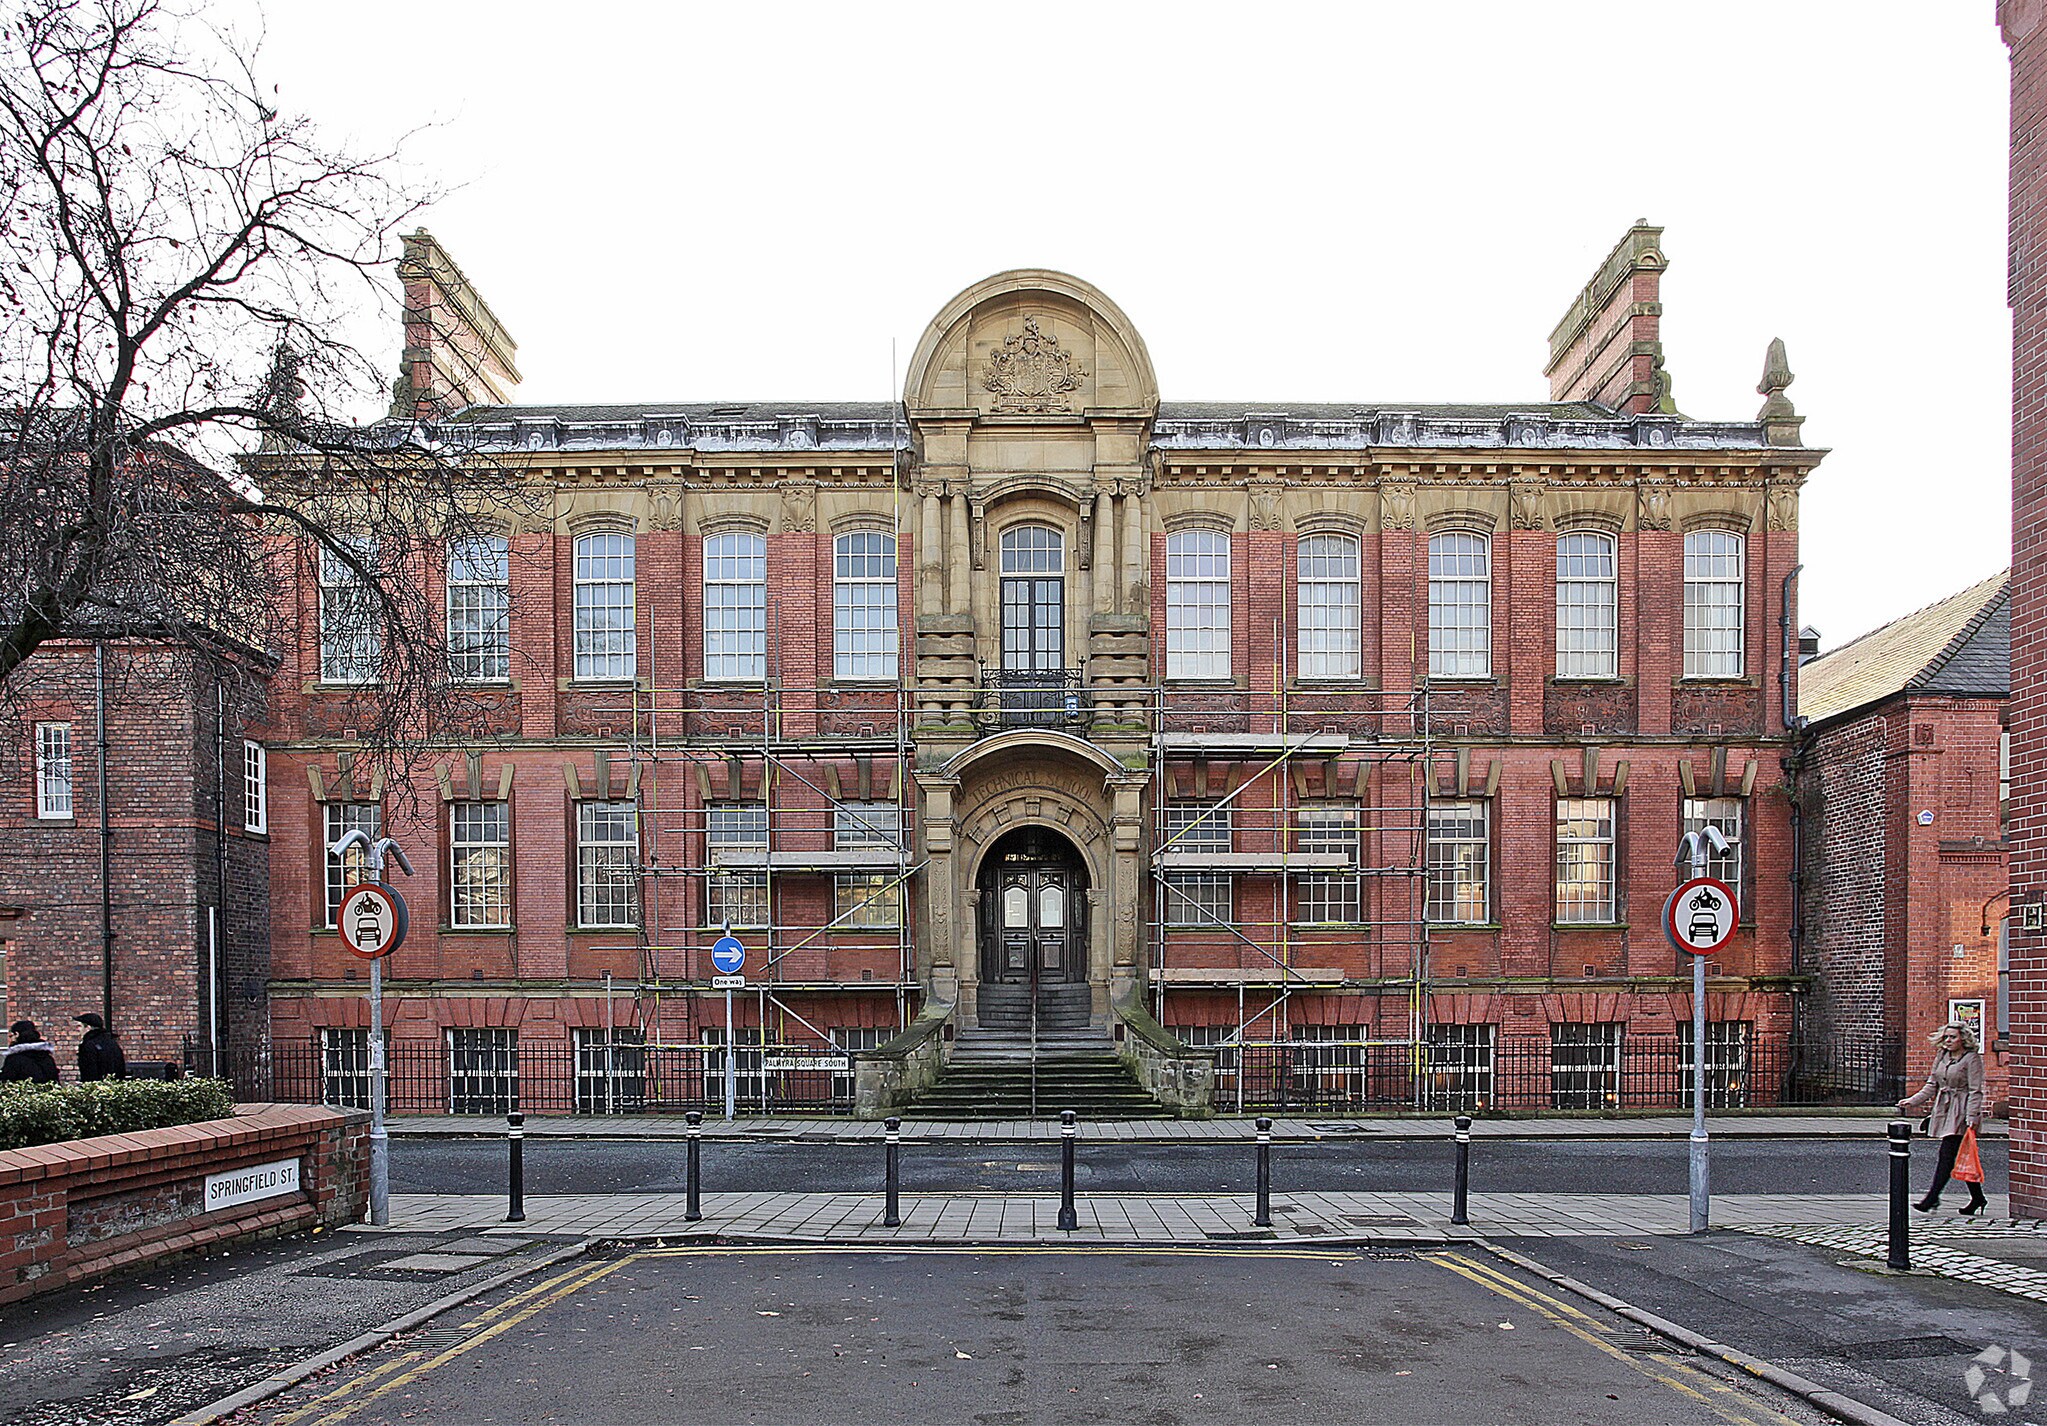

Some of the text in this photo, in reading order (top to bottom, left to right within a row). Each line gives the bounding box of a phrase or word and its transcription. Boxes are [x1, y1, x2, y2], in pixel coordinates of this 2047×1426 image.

[969, 770, 1094, 806] TECHNICAL SCHOOL
[714, 978, 728, 986] One
[766, 1060, 846, 1068] PALMYRA SQUARE SOUTH
[210, 1167, 296, 1200] SPRINGFIELD ST.
